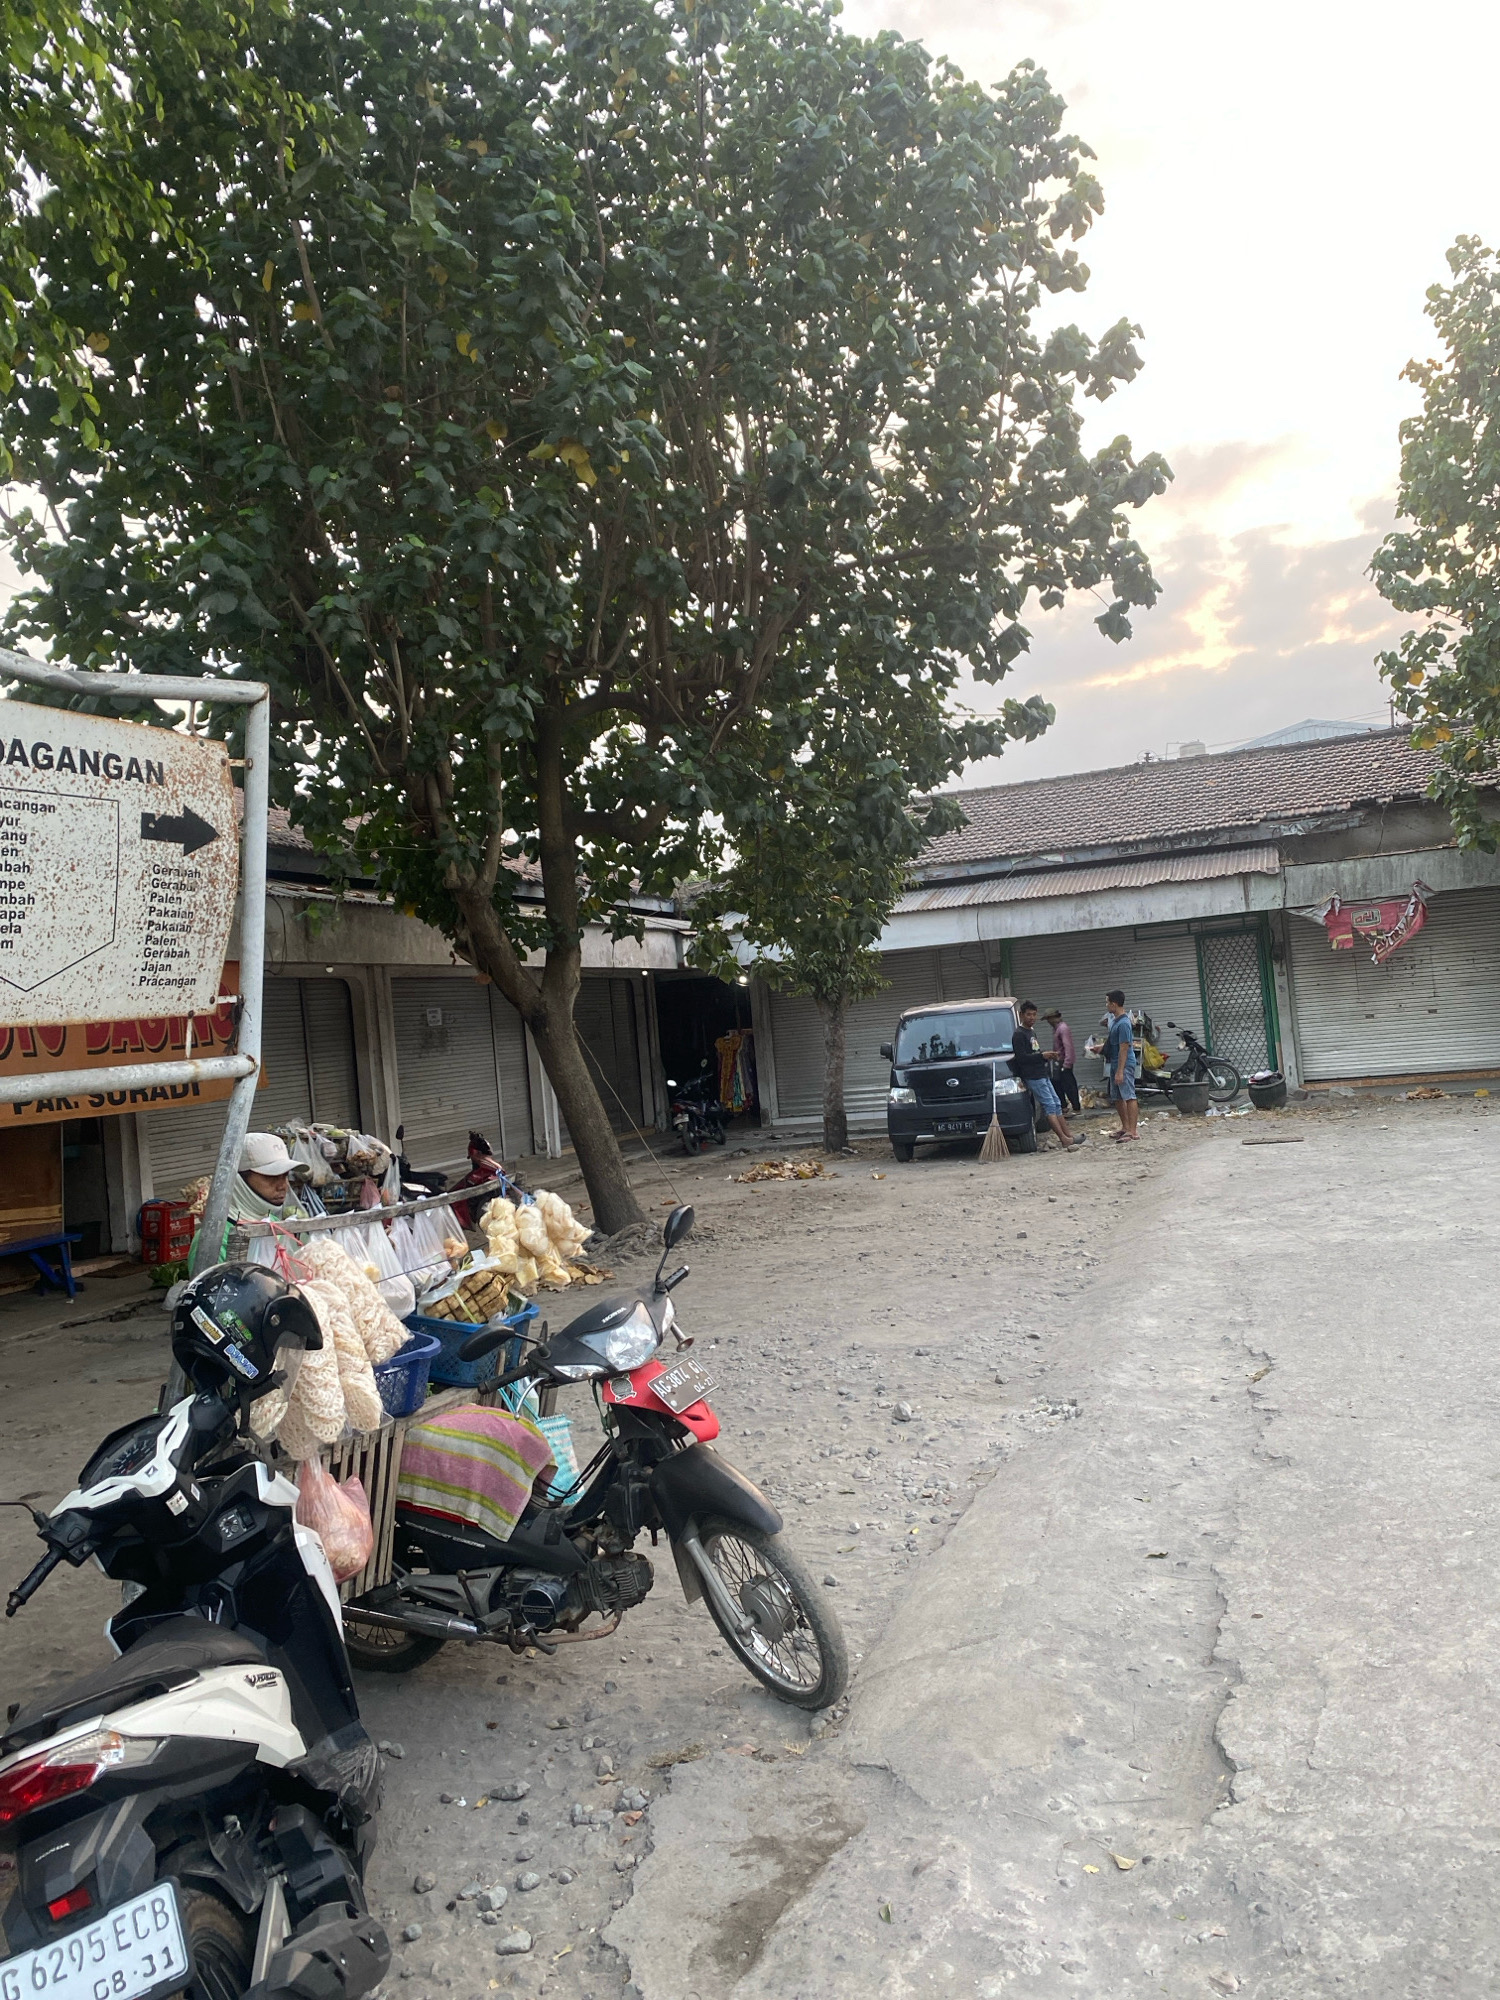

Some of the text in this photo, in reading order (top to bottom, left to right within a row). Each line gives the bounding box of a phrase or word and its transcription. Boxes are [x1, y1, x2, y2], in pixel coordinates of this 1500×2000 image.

[0, 738, 164, 786] AGANGAN
[149, 892, 182, 904] Palen
[148, 906, 194, 919] Pakaian
[147, 920, 192, 933] Pakaian
[145, 934, 177, 946] Palen
[143, 947, 190, 959] Gerabah
[140, 961, 172, 974] Jajan
[139, 975, 197, 989] Pracangan
[653, 1380, 672, 1398] AG
[665, 1367, 691, 1388] 3874
[31, 1926, 106, 1991] 6295
[112, 1897, 170, 1951] ECB
